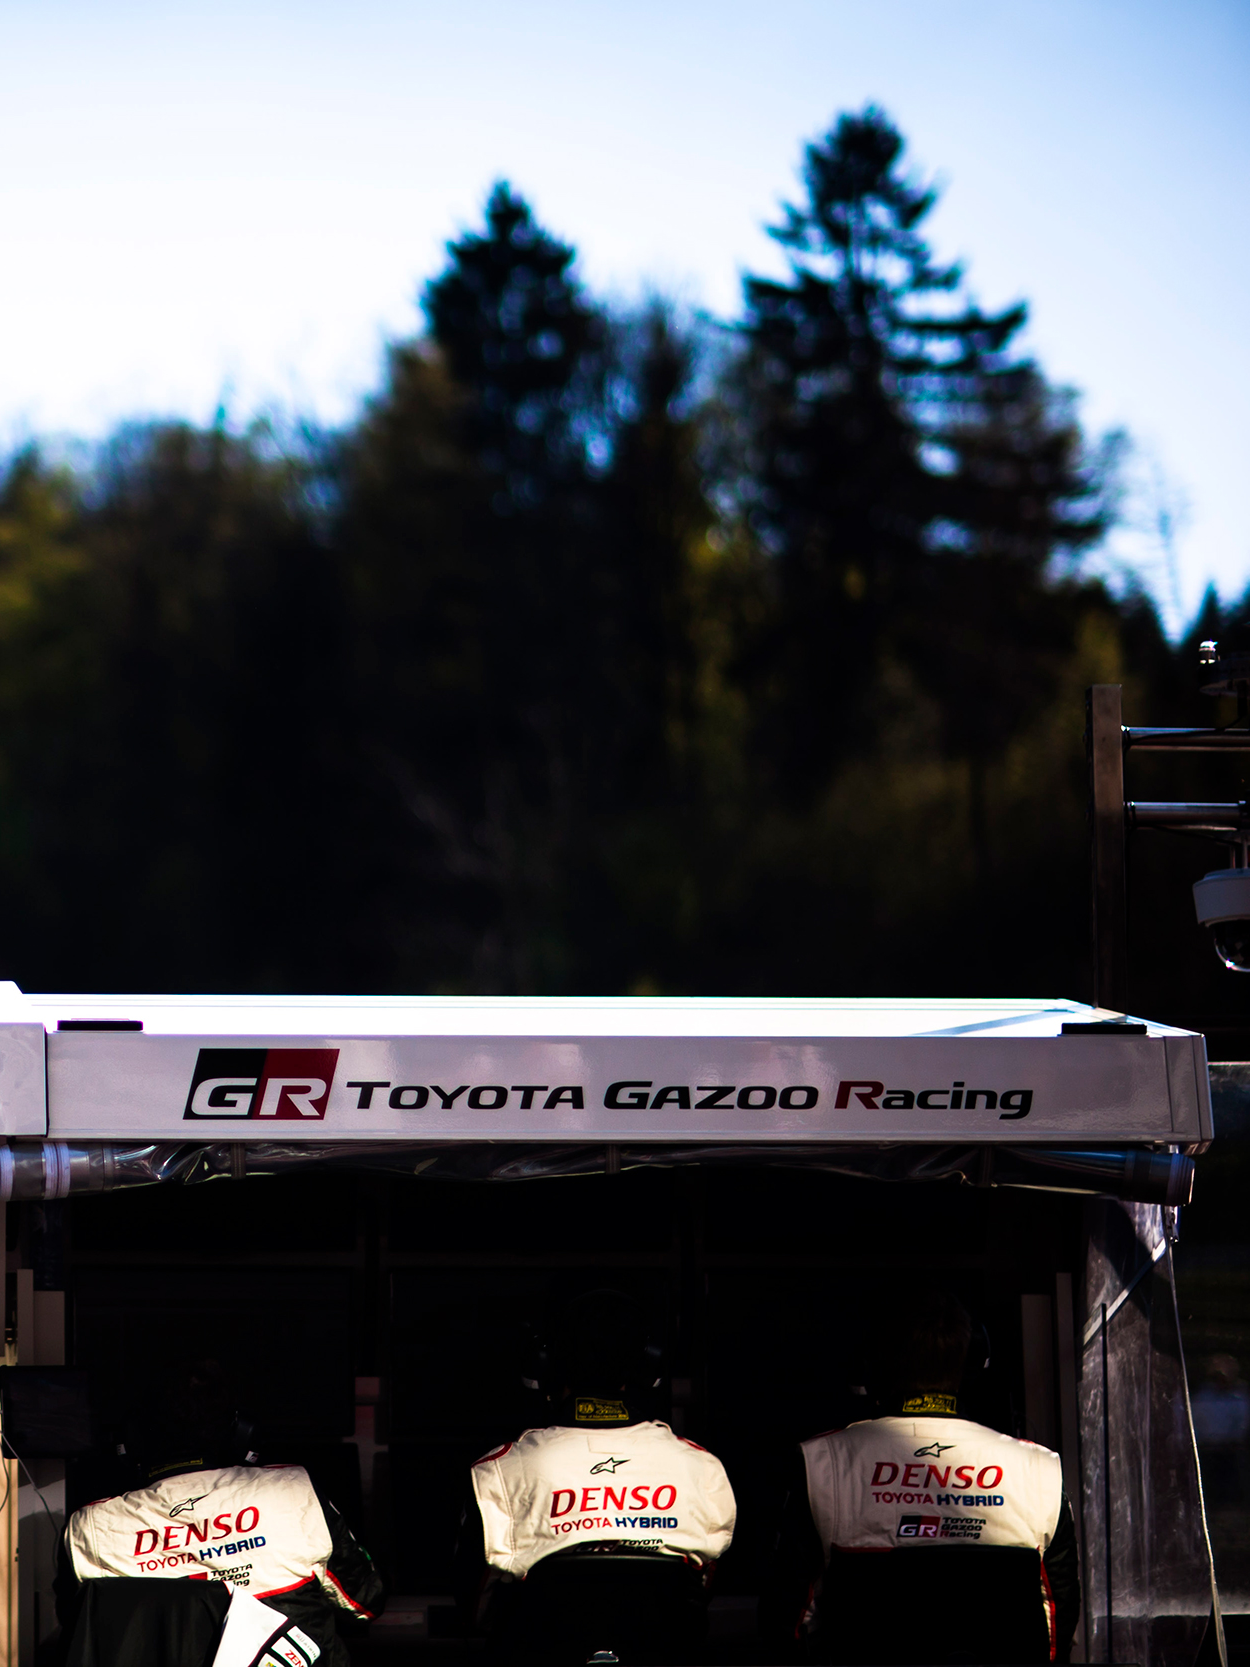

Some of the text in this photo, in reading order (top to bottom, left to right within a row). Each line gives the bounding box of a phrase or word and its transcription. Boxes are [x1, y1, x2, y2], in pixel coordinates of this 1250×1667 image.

[191, 1078, 327, 1116] GR
[346, 1081, 1034, 1120] TOYOTA GAZOO Racing
[870, 1462, 1003, 1489] DENSO
[550, 1485, 677, 1518] DENSO
[872, 1492, 1004, 1507] TOYOTA HYBRID
[134, 1506, 260, 1556] DENSO
[551, 1517, 678, 1535] TOYOTA HYBRID
[942, 1517, 987, 1525] TOYOTA
[621, 1538, 663, 1546] TOYOTA
[939, 1531, 981, 1539] Racing
[137, 1536, 266, 1573] TOYOTA HYBRID
[211, 1563, 253, 1577] TOYOTA
